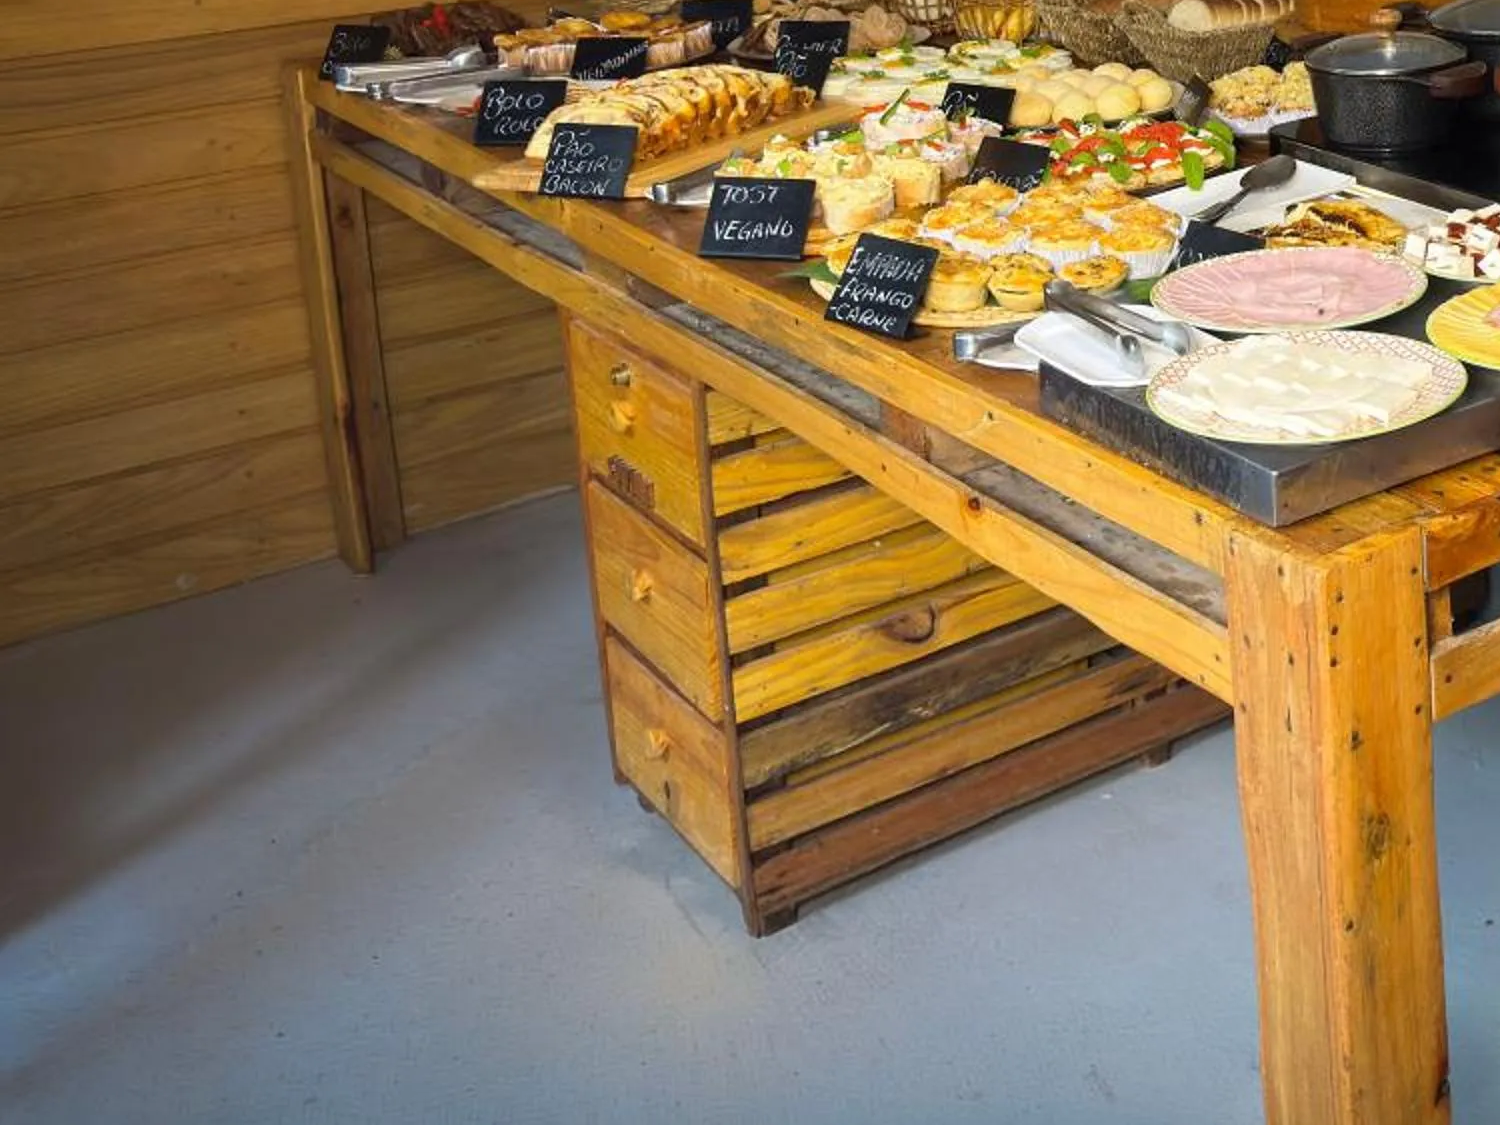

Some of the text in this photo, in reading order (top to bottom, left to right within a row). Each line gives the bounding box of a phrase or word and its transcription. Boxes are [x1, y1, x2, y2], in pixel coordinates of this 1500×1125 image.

[484, 86, 544, 120] BOLO
[553, 128, 594, 157] PÃO
[545, 155, 624, 174] CASEIRO
[543, 175, 611, 196] BACON
[719, 184, 781, 207] TOST
[713, 216, 794, 241] VEGANO
